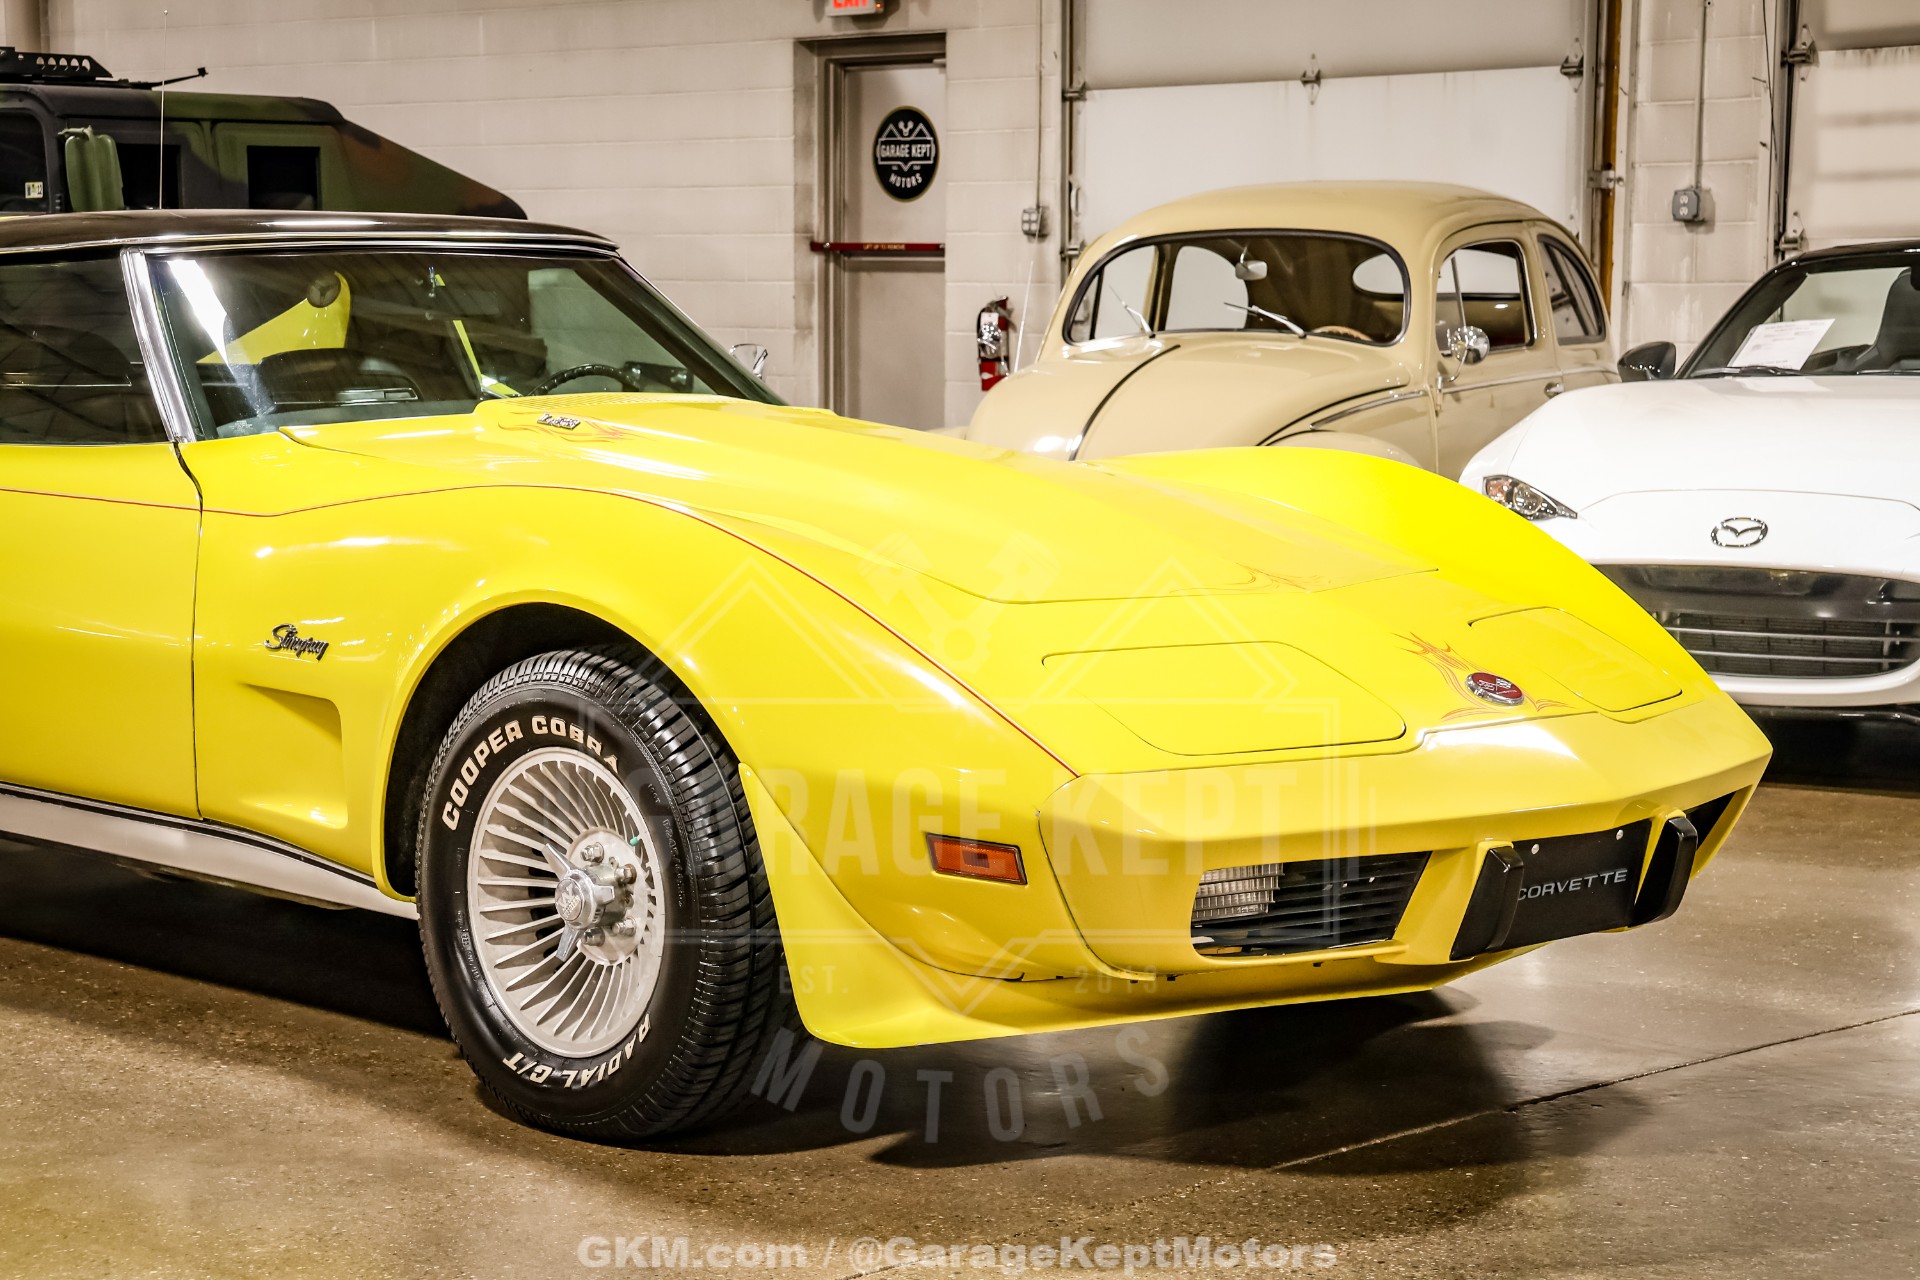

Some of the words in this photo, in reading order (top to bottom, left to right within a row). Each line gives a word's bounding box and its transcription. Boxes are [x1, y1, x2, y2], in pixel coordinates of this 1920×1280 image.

[880, 144, 910, 157] GARAGE
[911, 144, 931, 157] KEPT
[889, 172, 923, 188] MOTORS
[263, 623, 330, 661] Stingray
[442, 720, 524, 831] COOPER
[532, 715, 619, 774] COBRA
[1518, 868, 1627, 900] CORVETTE
[562, 1013, 651, 1088] RADIAL
[502, 1052, 553, 1084] G/T
